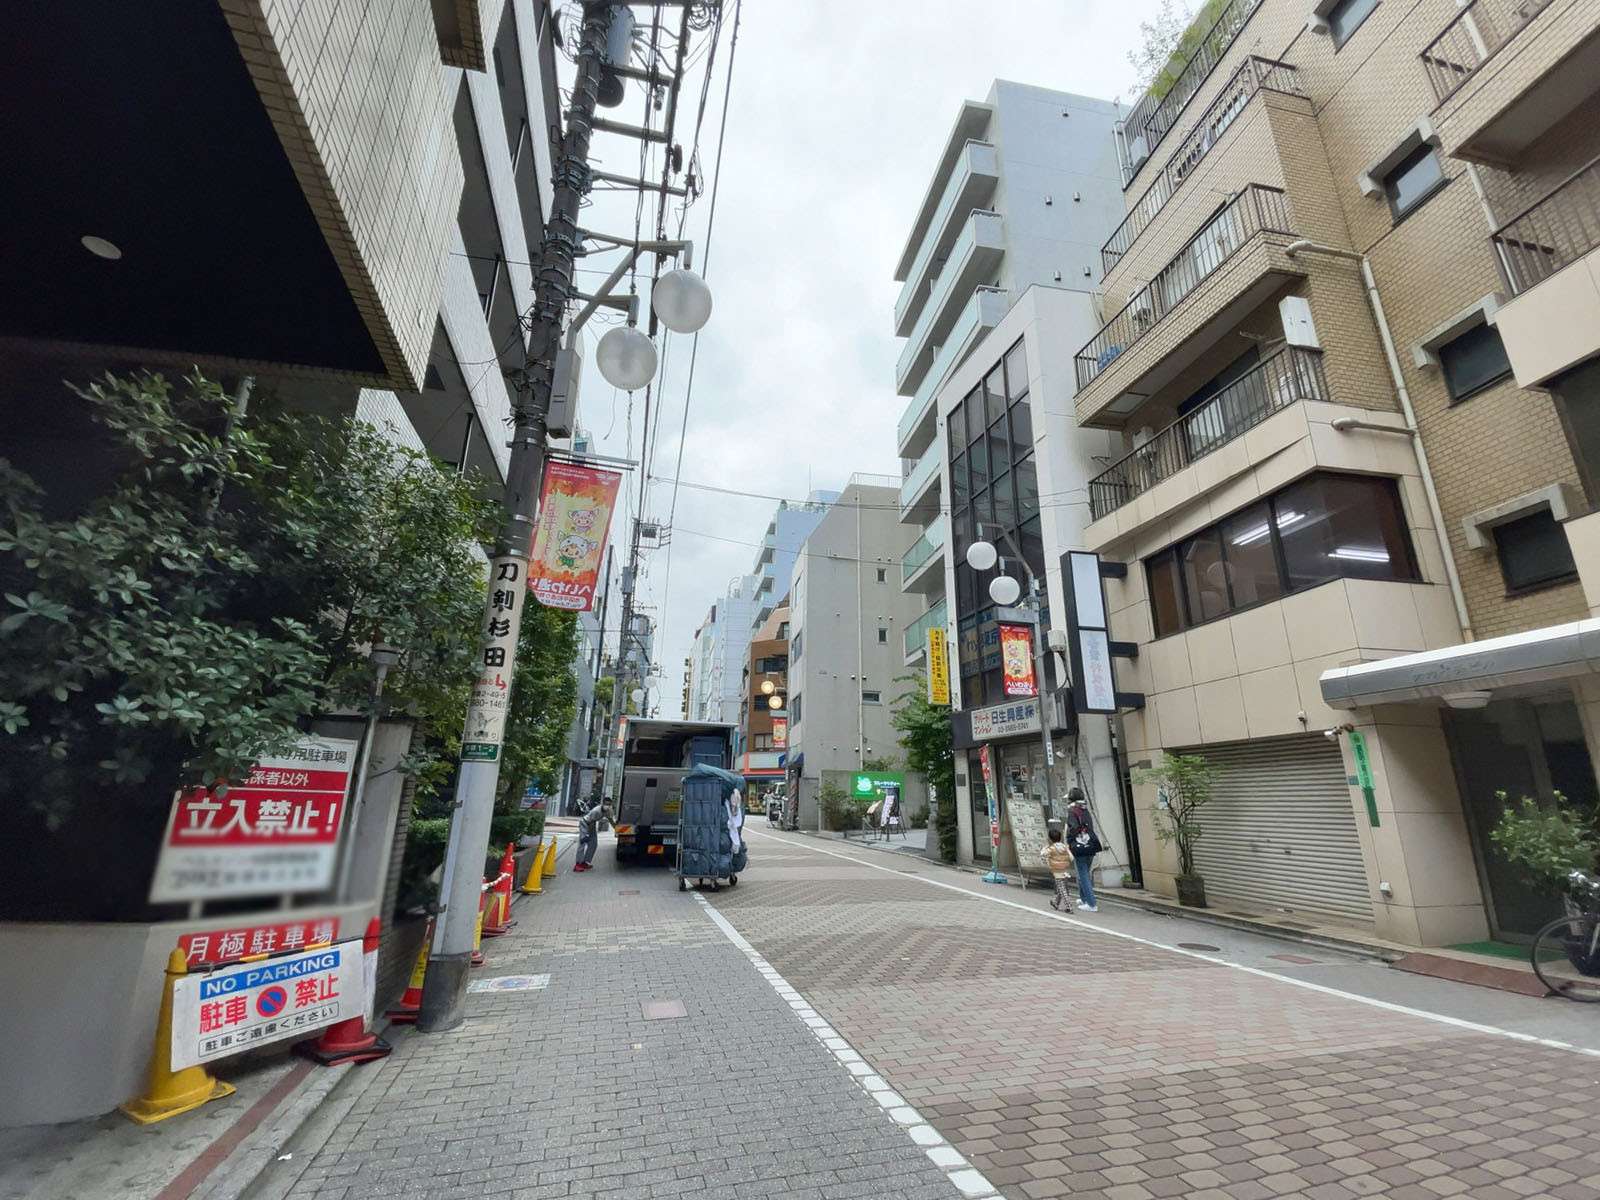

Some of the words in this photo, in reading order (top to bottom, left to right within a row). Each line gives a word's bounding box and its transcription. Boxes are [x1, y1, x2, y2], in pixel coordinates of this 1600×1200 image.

[483, 562, 520, 669] 刀剣杉田
[991, 703, 1039, 725] 日生興産株
[185, 919, 335, 963] 月極駐車場
[206, 976, 237, 997] NO
[246, 954, 335, 987] PARKING
[199, 995, 249, 1035] 駐車
[294, 973, 341, 1009] 禁止
[205, 1006, 334, 1053] 駐車ご遠慮ください
